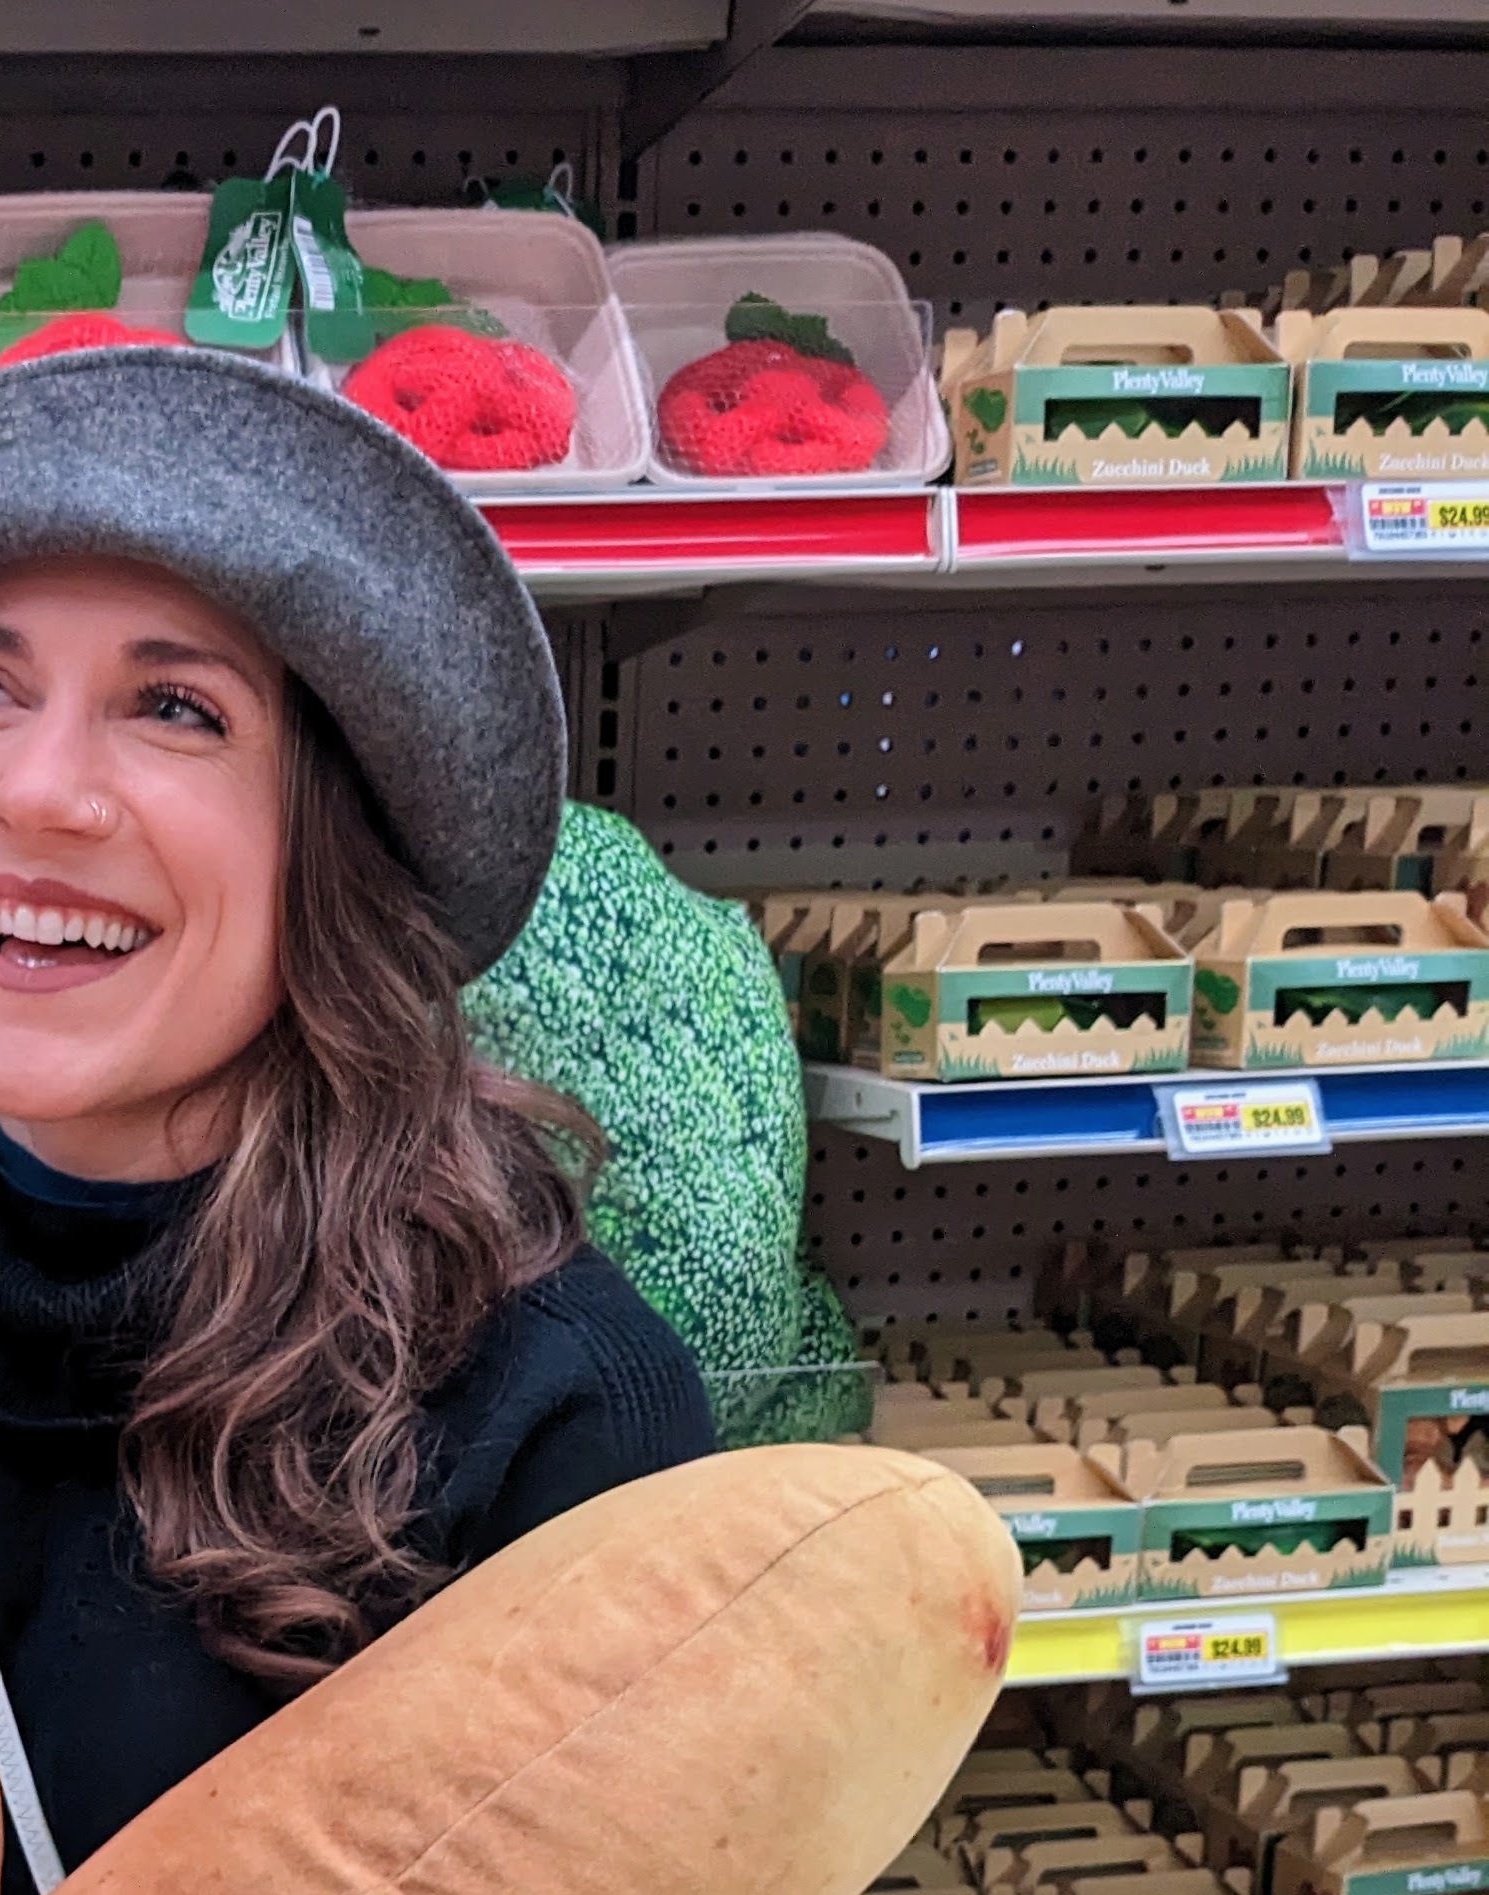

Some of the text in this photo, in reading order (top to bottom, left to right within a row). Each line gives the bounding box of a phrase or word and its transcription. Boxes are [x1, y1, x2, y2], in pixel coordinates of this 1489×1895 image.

[1092, 456, 1210, 478] Zucchini Duck
[1378, 453, 1446, 471] Zucchini
[1439, 505, 1489, 527] $24.99
[1251, 1107, 1305, 1129] $24.99
[1211, 1637, 1263, 1658] $24.99
